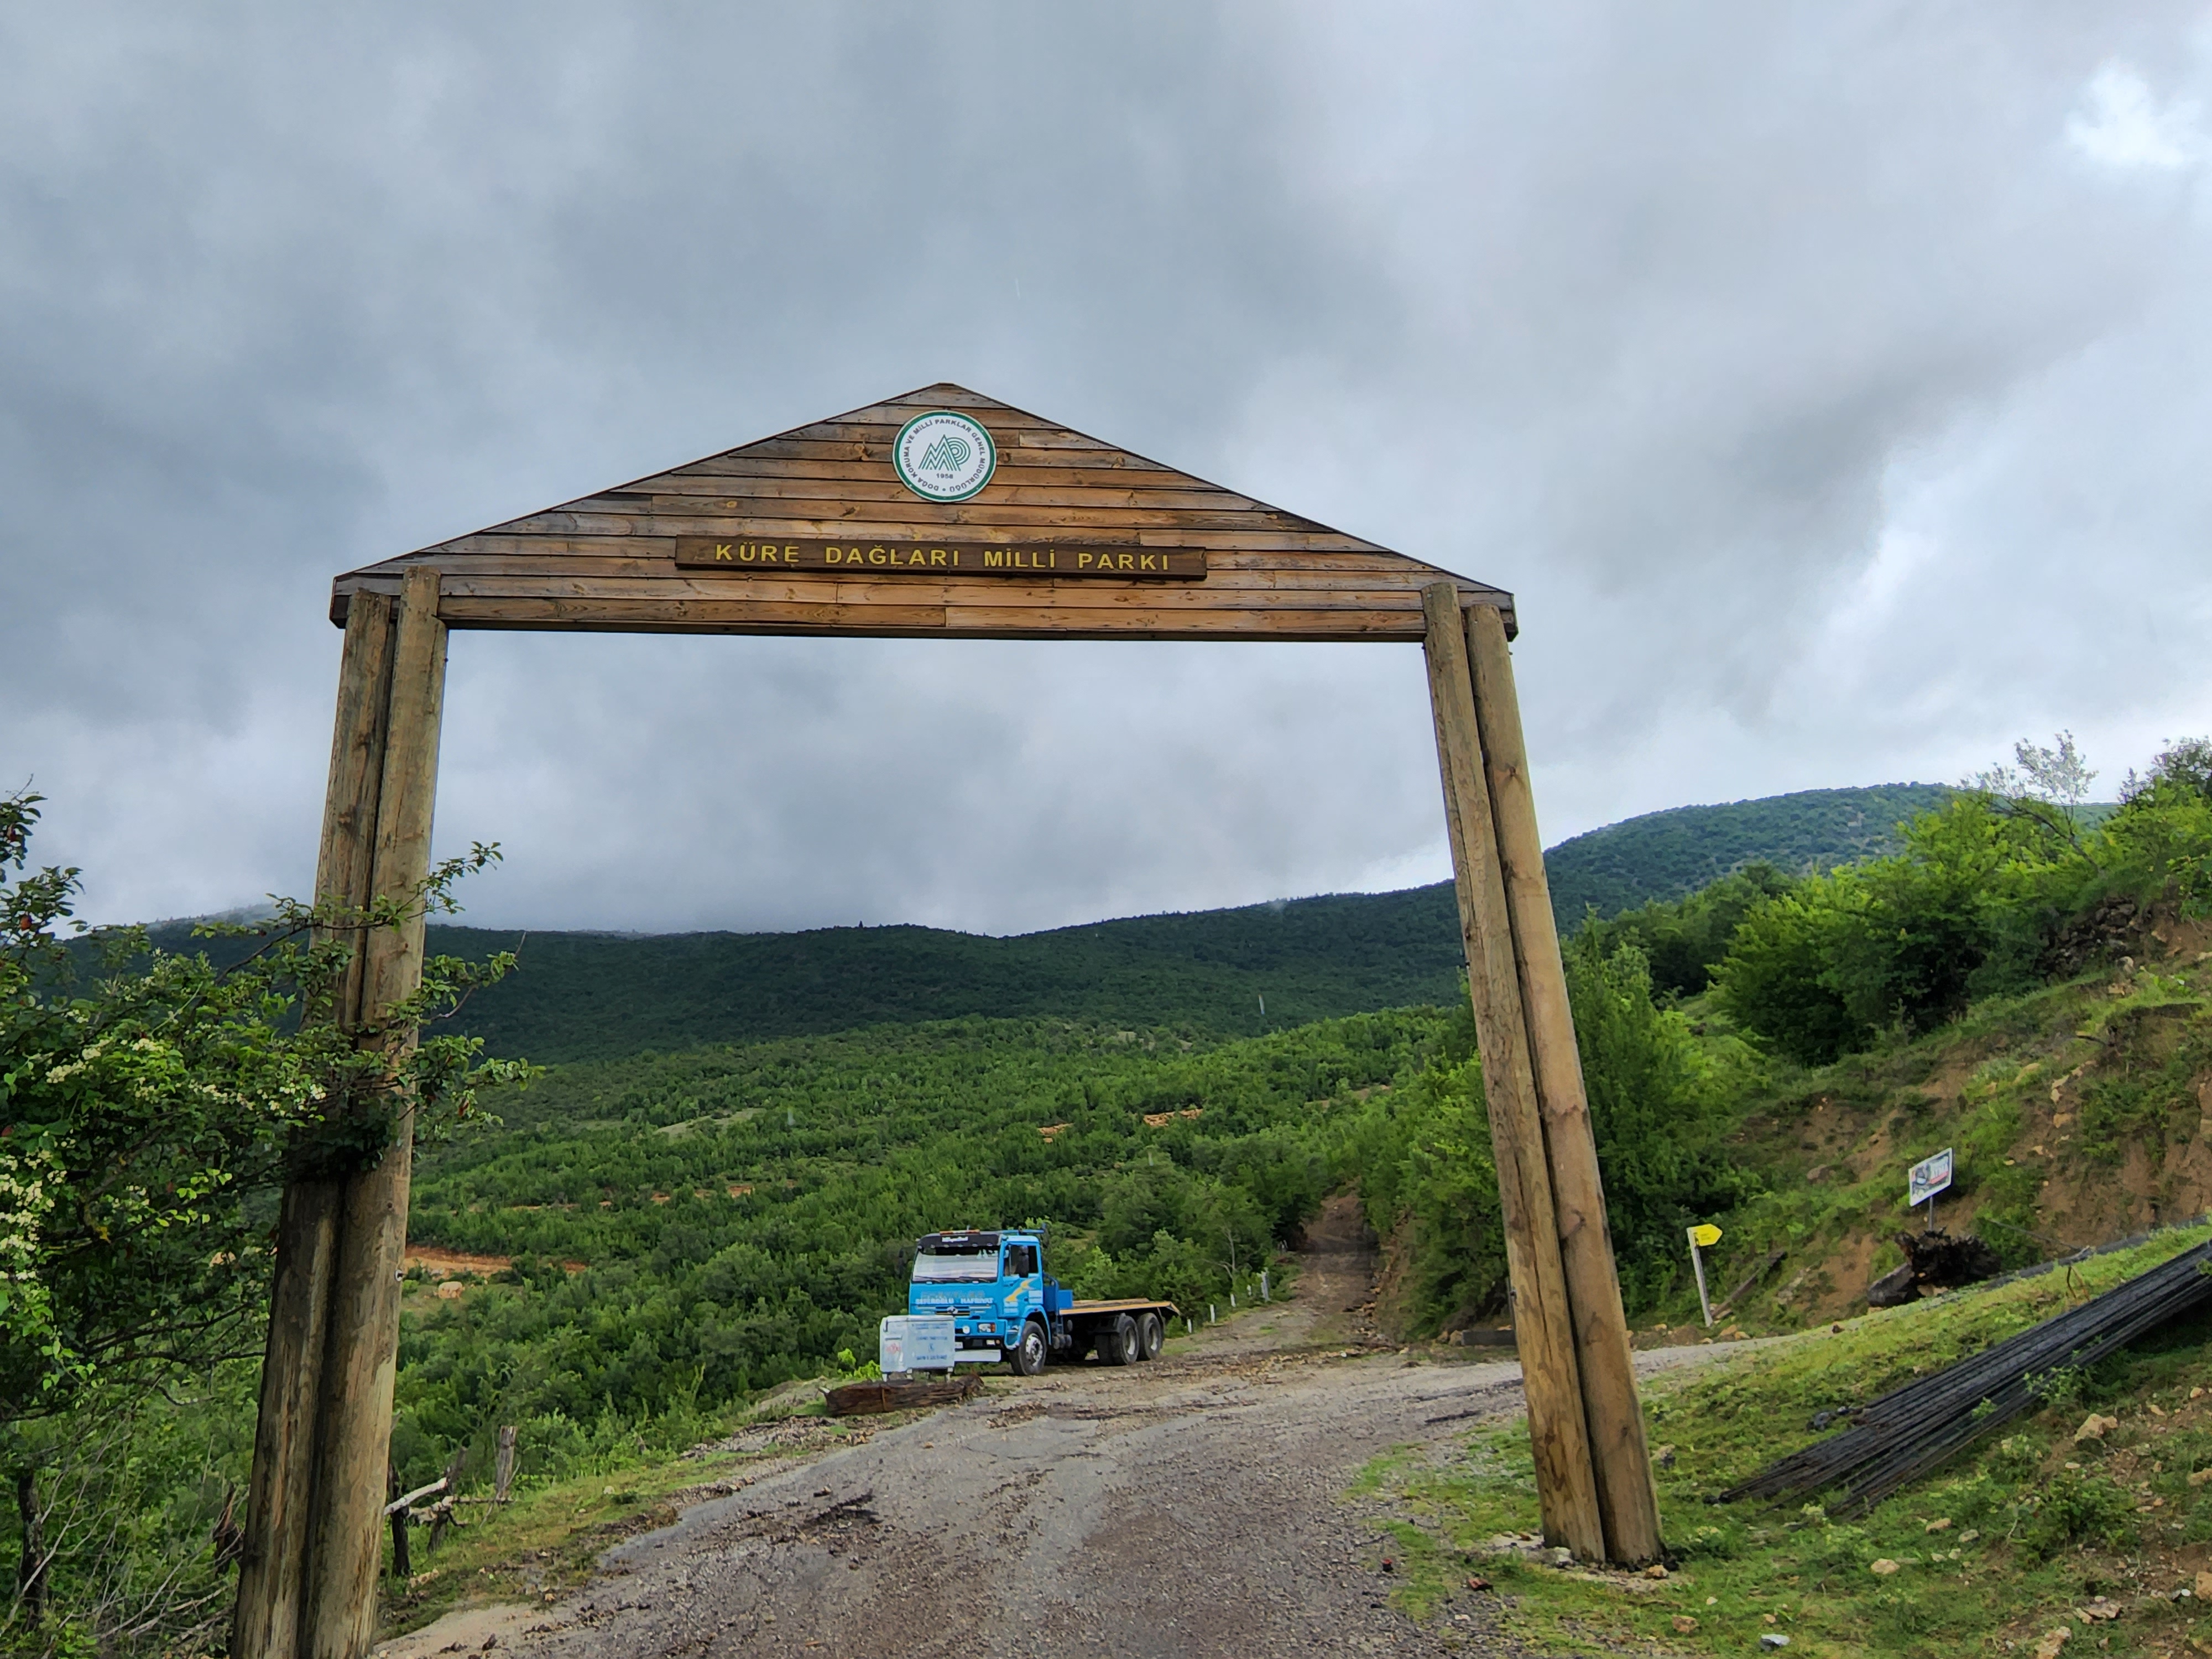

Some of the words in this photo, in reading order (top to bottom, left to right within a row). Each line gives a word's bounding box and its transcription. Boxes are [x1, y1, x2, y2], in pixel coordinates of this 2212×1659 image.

[913, 420, 933, 435] MİLLİ
[935, 419, 972, 432] PARKLAR
[906, 435, 915, 445] VE
[972, 432, 986, 456] GENEL
[904, 446, 918, 479] KORUMA
[917, 477, 940, 491] DOĞA
[715, 541, 800, 563] KÜRE
[825, 545, 959, 566] DAĞLARI
[984, 547, 1055, 568] MİLLİ
[1078, 552, 1168, 570] PARKI
